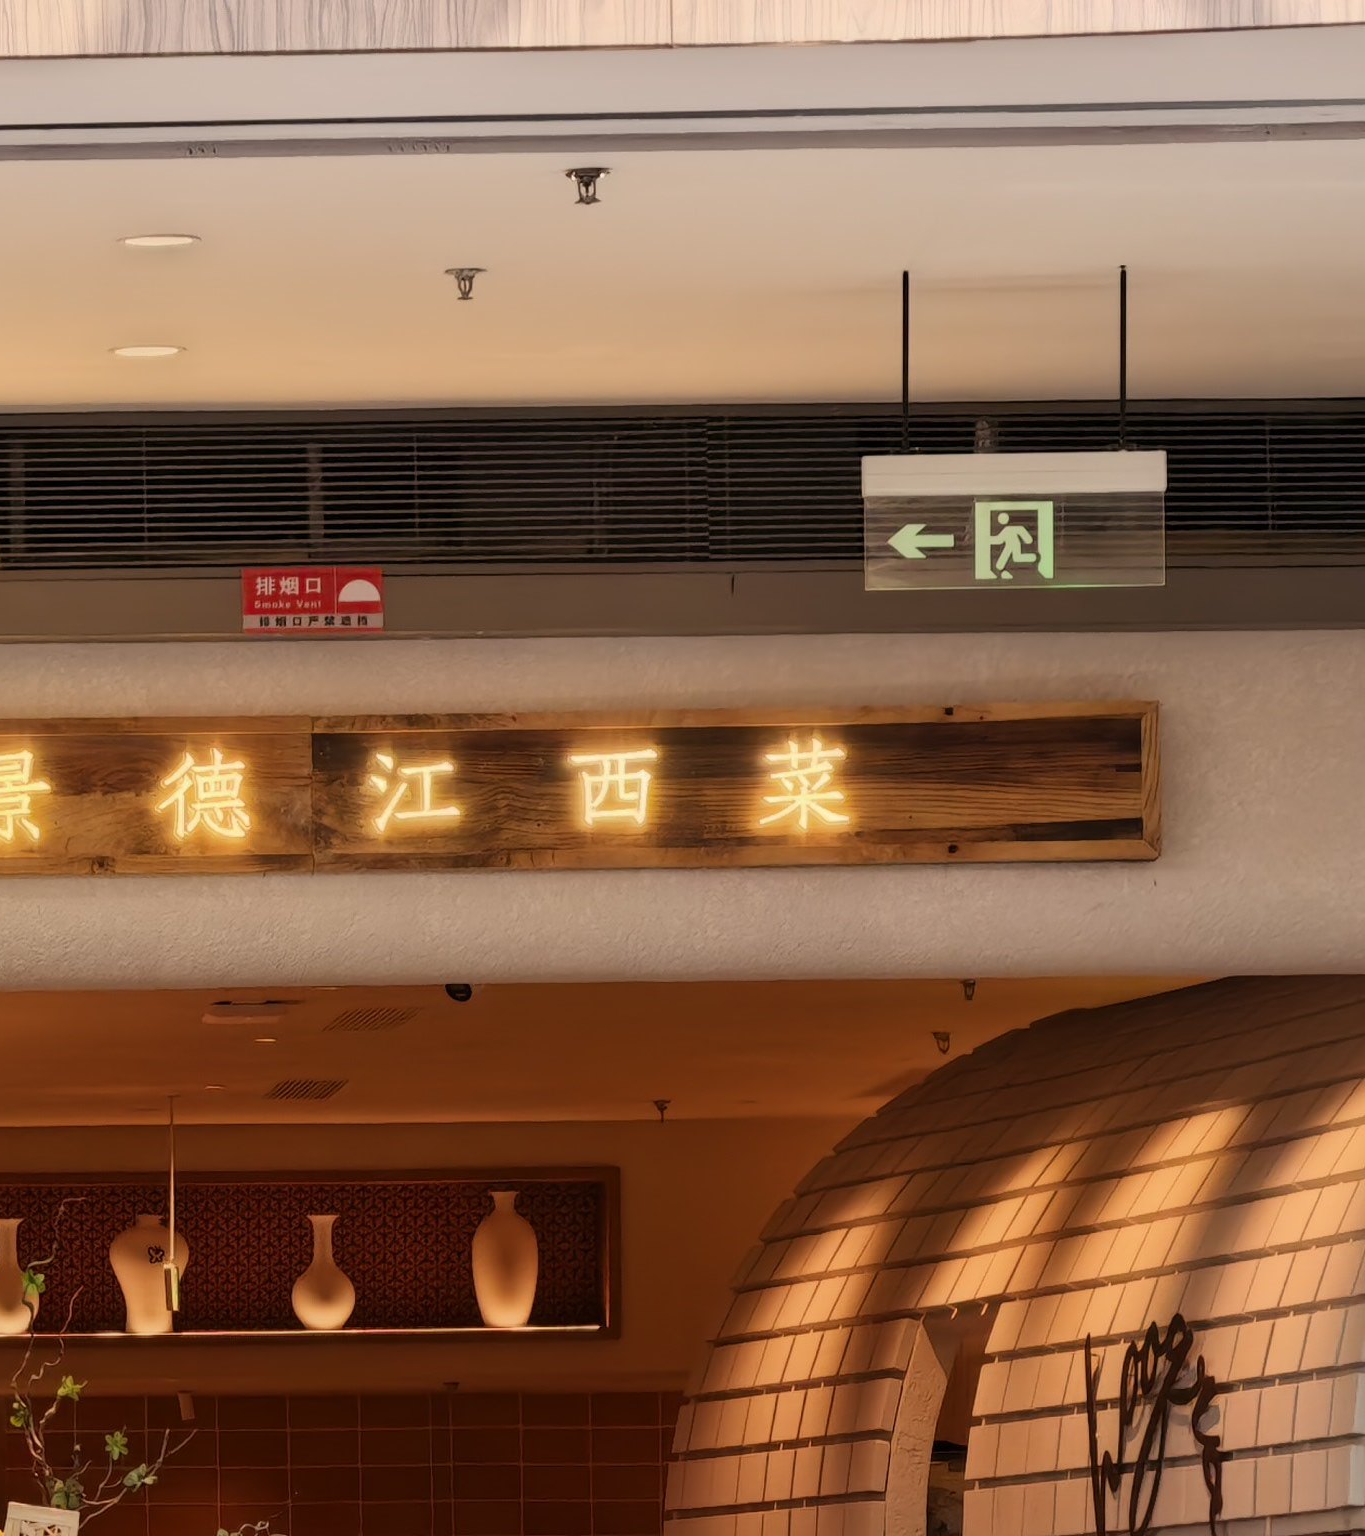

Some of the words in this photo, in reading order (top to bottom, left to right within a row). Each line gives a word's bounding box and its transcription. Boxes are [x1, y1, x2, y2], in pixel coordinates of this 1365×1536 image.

[255, 576, 322, 596] 排烟口
[254, 600, 291, 609] Smoke
[296, 600, 322, 609] Vent
